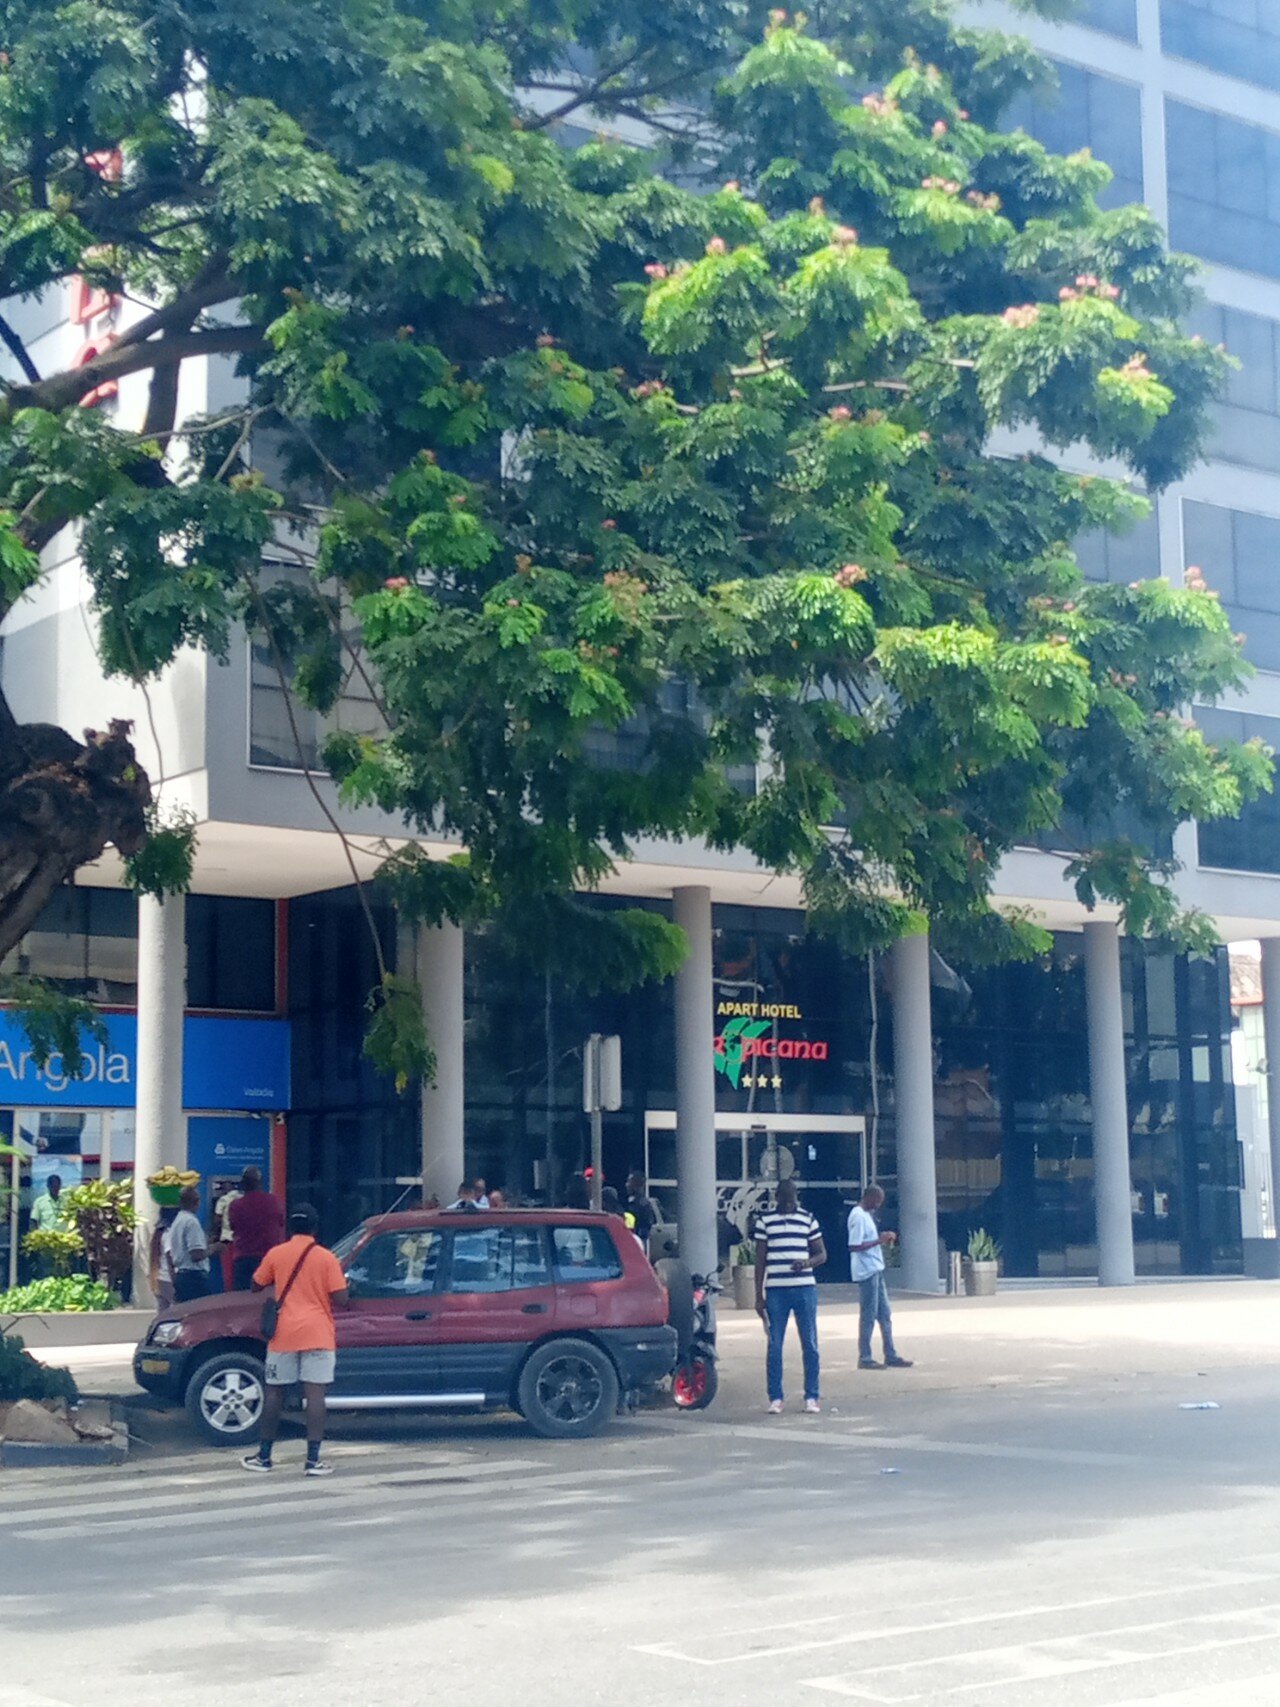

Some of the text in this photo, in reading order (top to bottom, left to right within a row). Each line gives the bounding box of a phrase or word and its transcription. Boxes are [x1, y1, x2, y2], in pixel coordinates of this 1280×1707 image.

[716, 1002, 802, 1019] APART HOTEL
[0, 1040, 130, 1092] Angola
